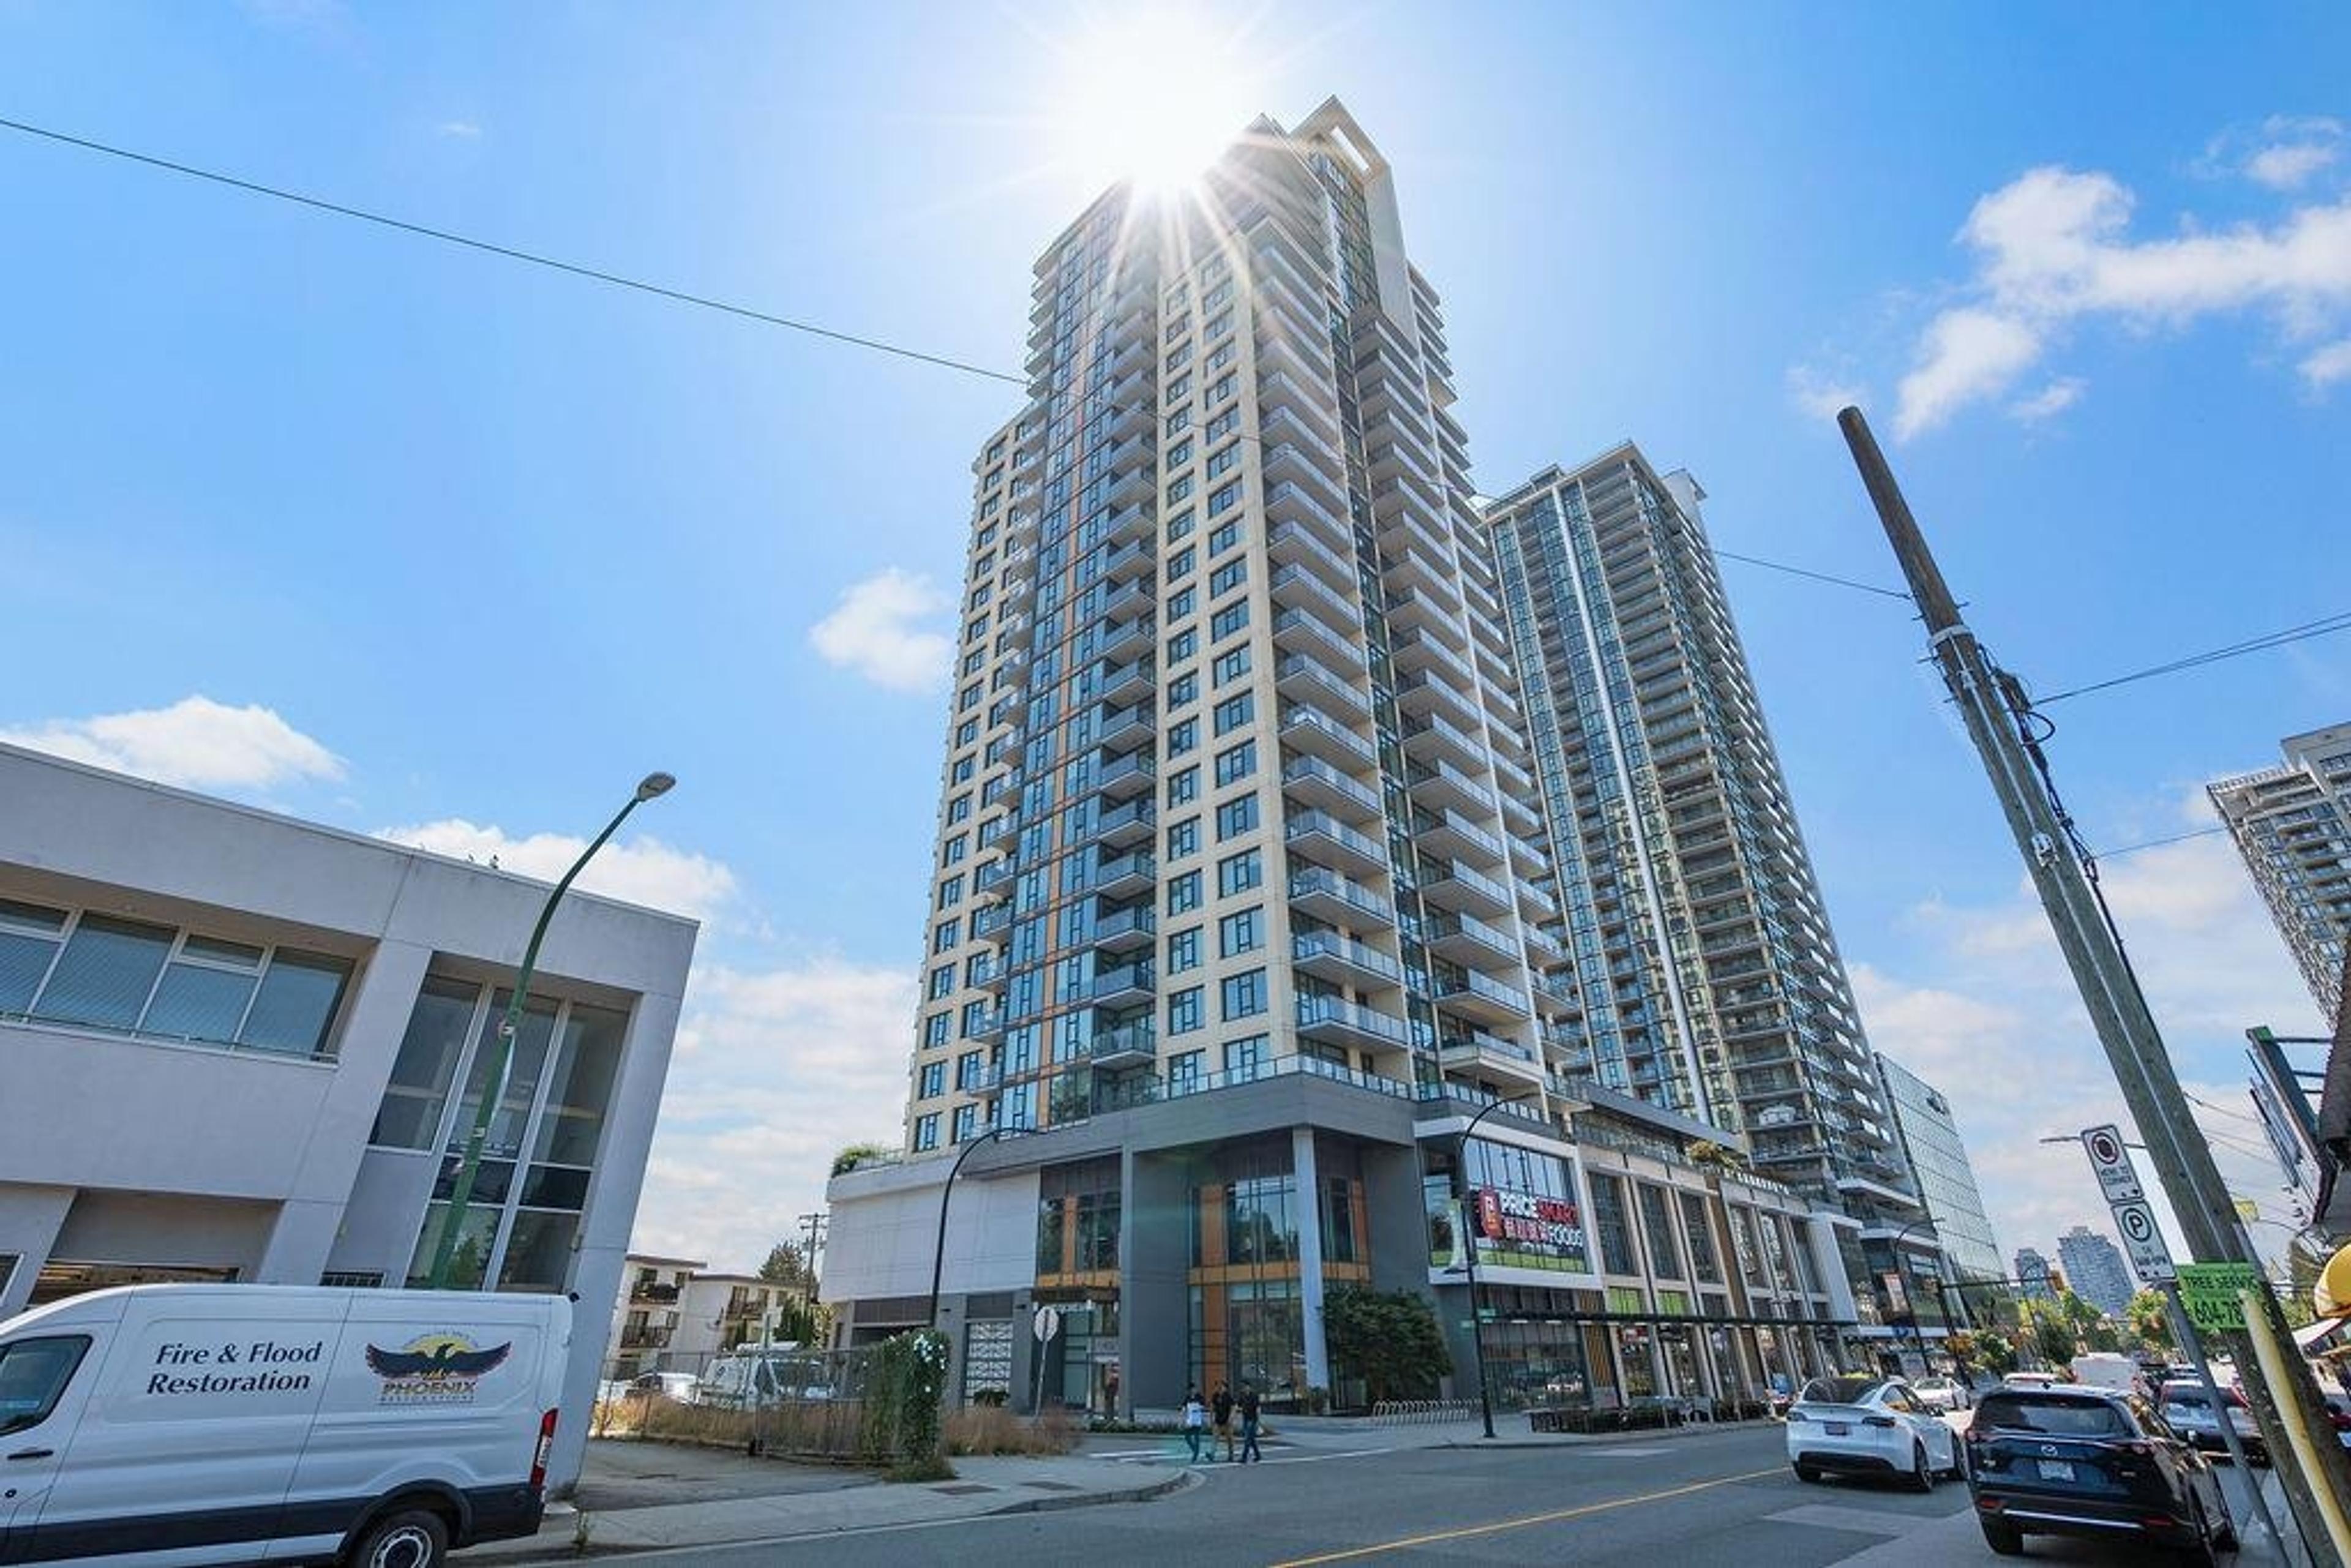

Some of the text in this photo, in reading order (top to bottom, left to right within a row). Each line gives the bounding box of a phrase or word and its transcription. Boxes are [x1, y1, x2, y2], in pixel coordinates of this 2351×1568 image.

[2183, 1275, 2214, 1289] TREE
[155, 1341, 323, 1365] Fire & Flood
[146, 1370, 311, 1395] Restoration
[381, 1381, 476, 1395] PHOENIX
